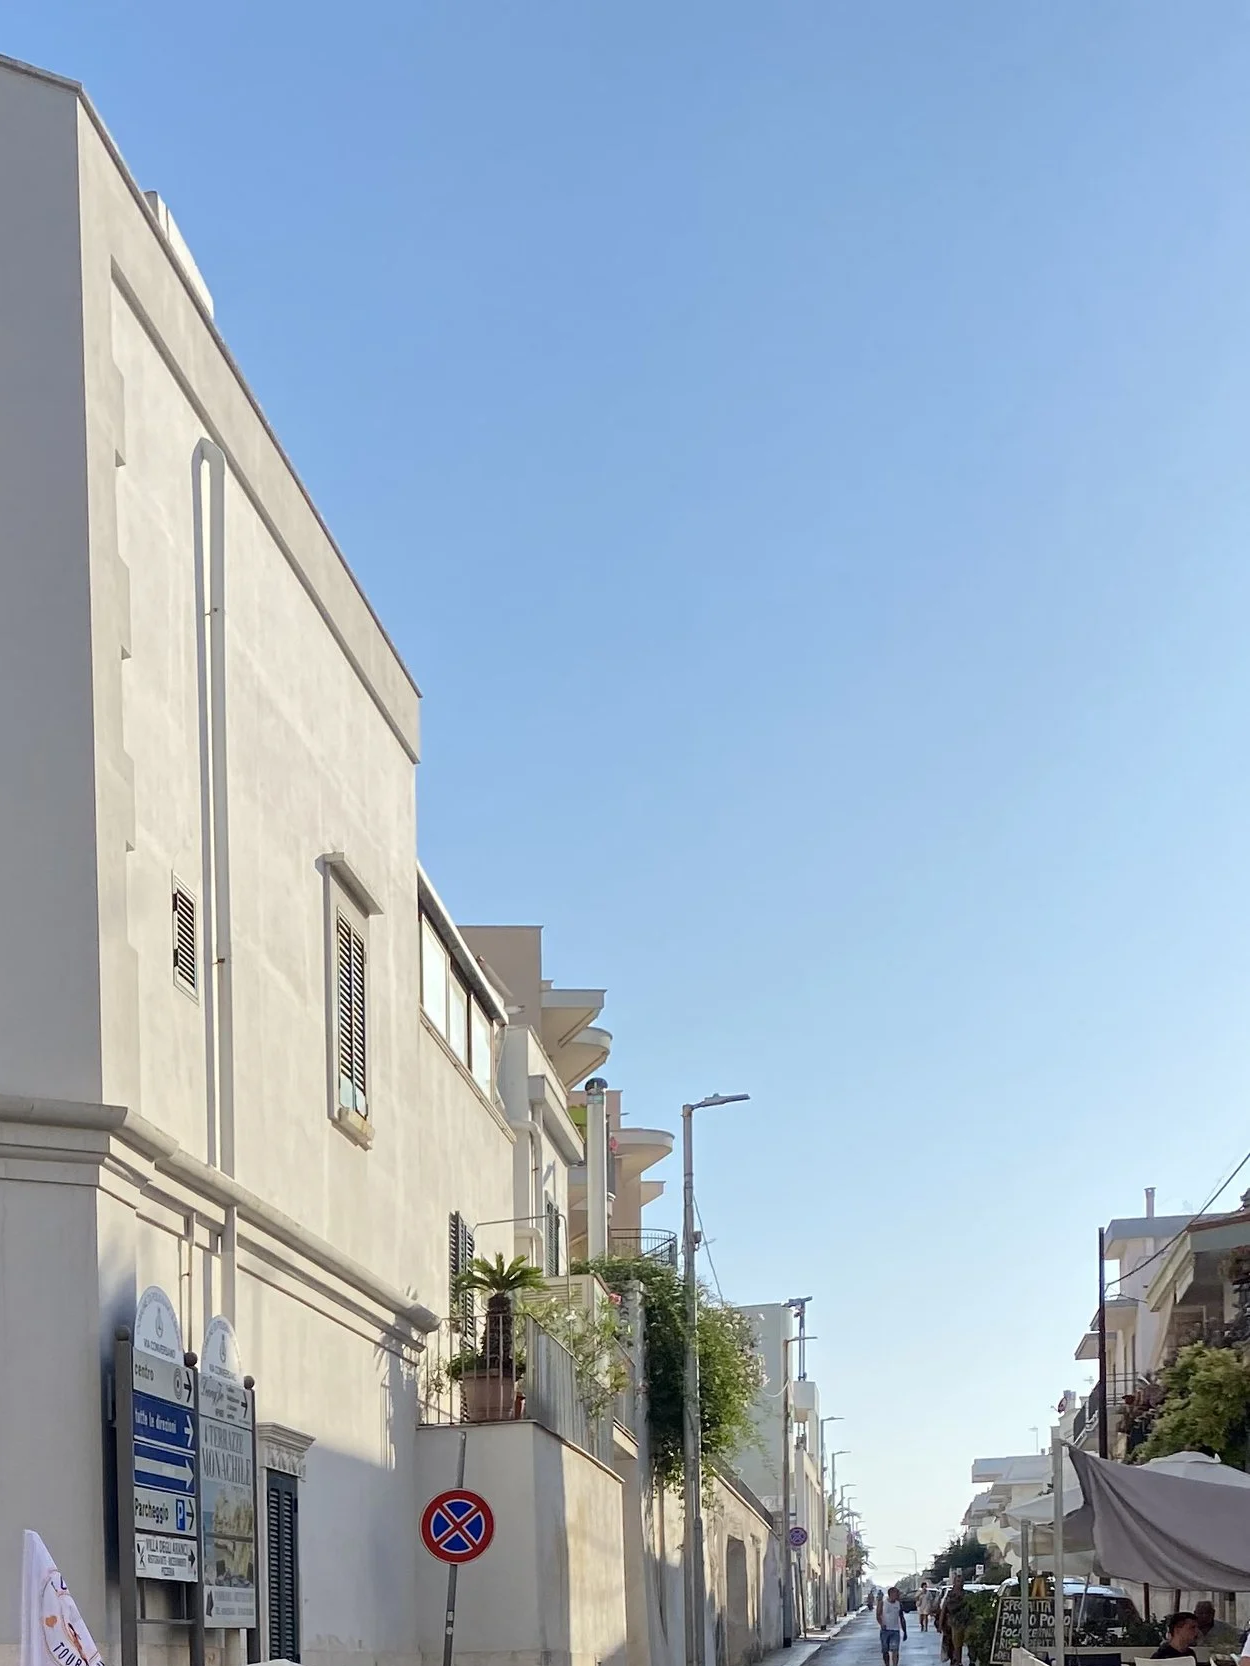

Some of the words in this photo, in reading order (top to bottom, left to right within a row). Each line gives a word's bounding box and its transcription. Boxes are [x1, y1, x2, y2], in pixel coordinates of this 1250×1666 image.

[135, 1364, 155, 1381] centro
[201, 1447, 251, 1486] MONACHILE
[135, 1498, 169, 1524] Parcheggio
